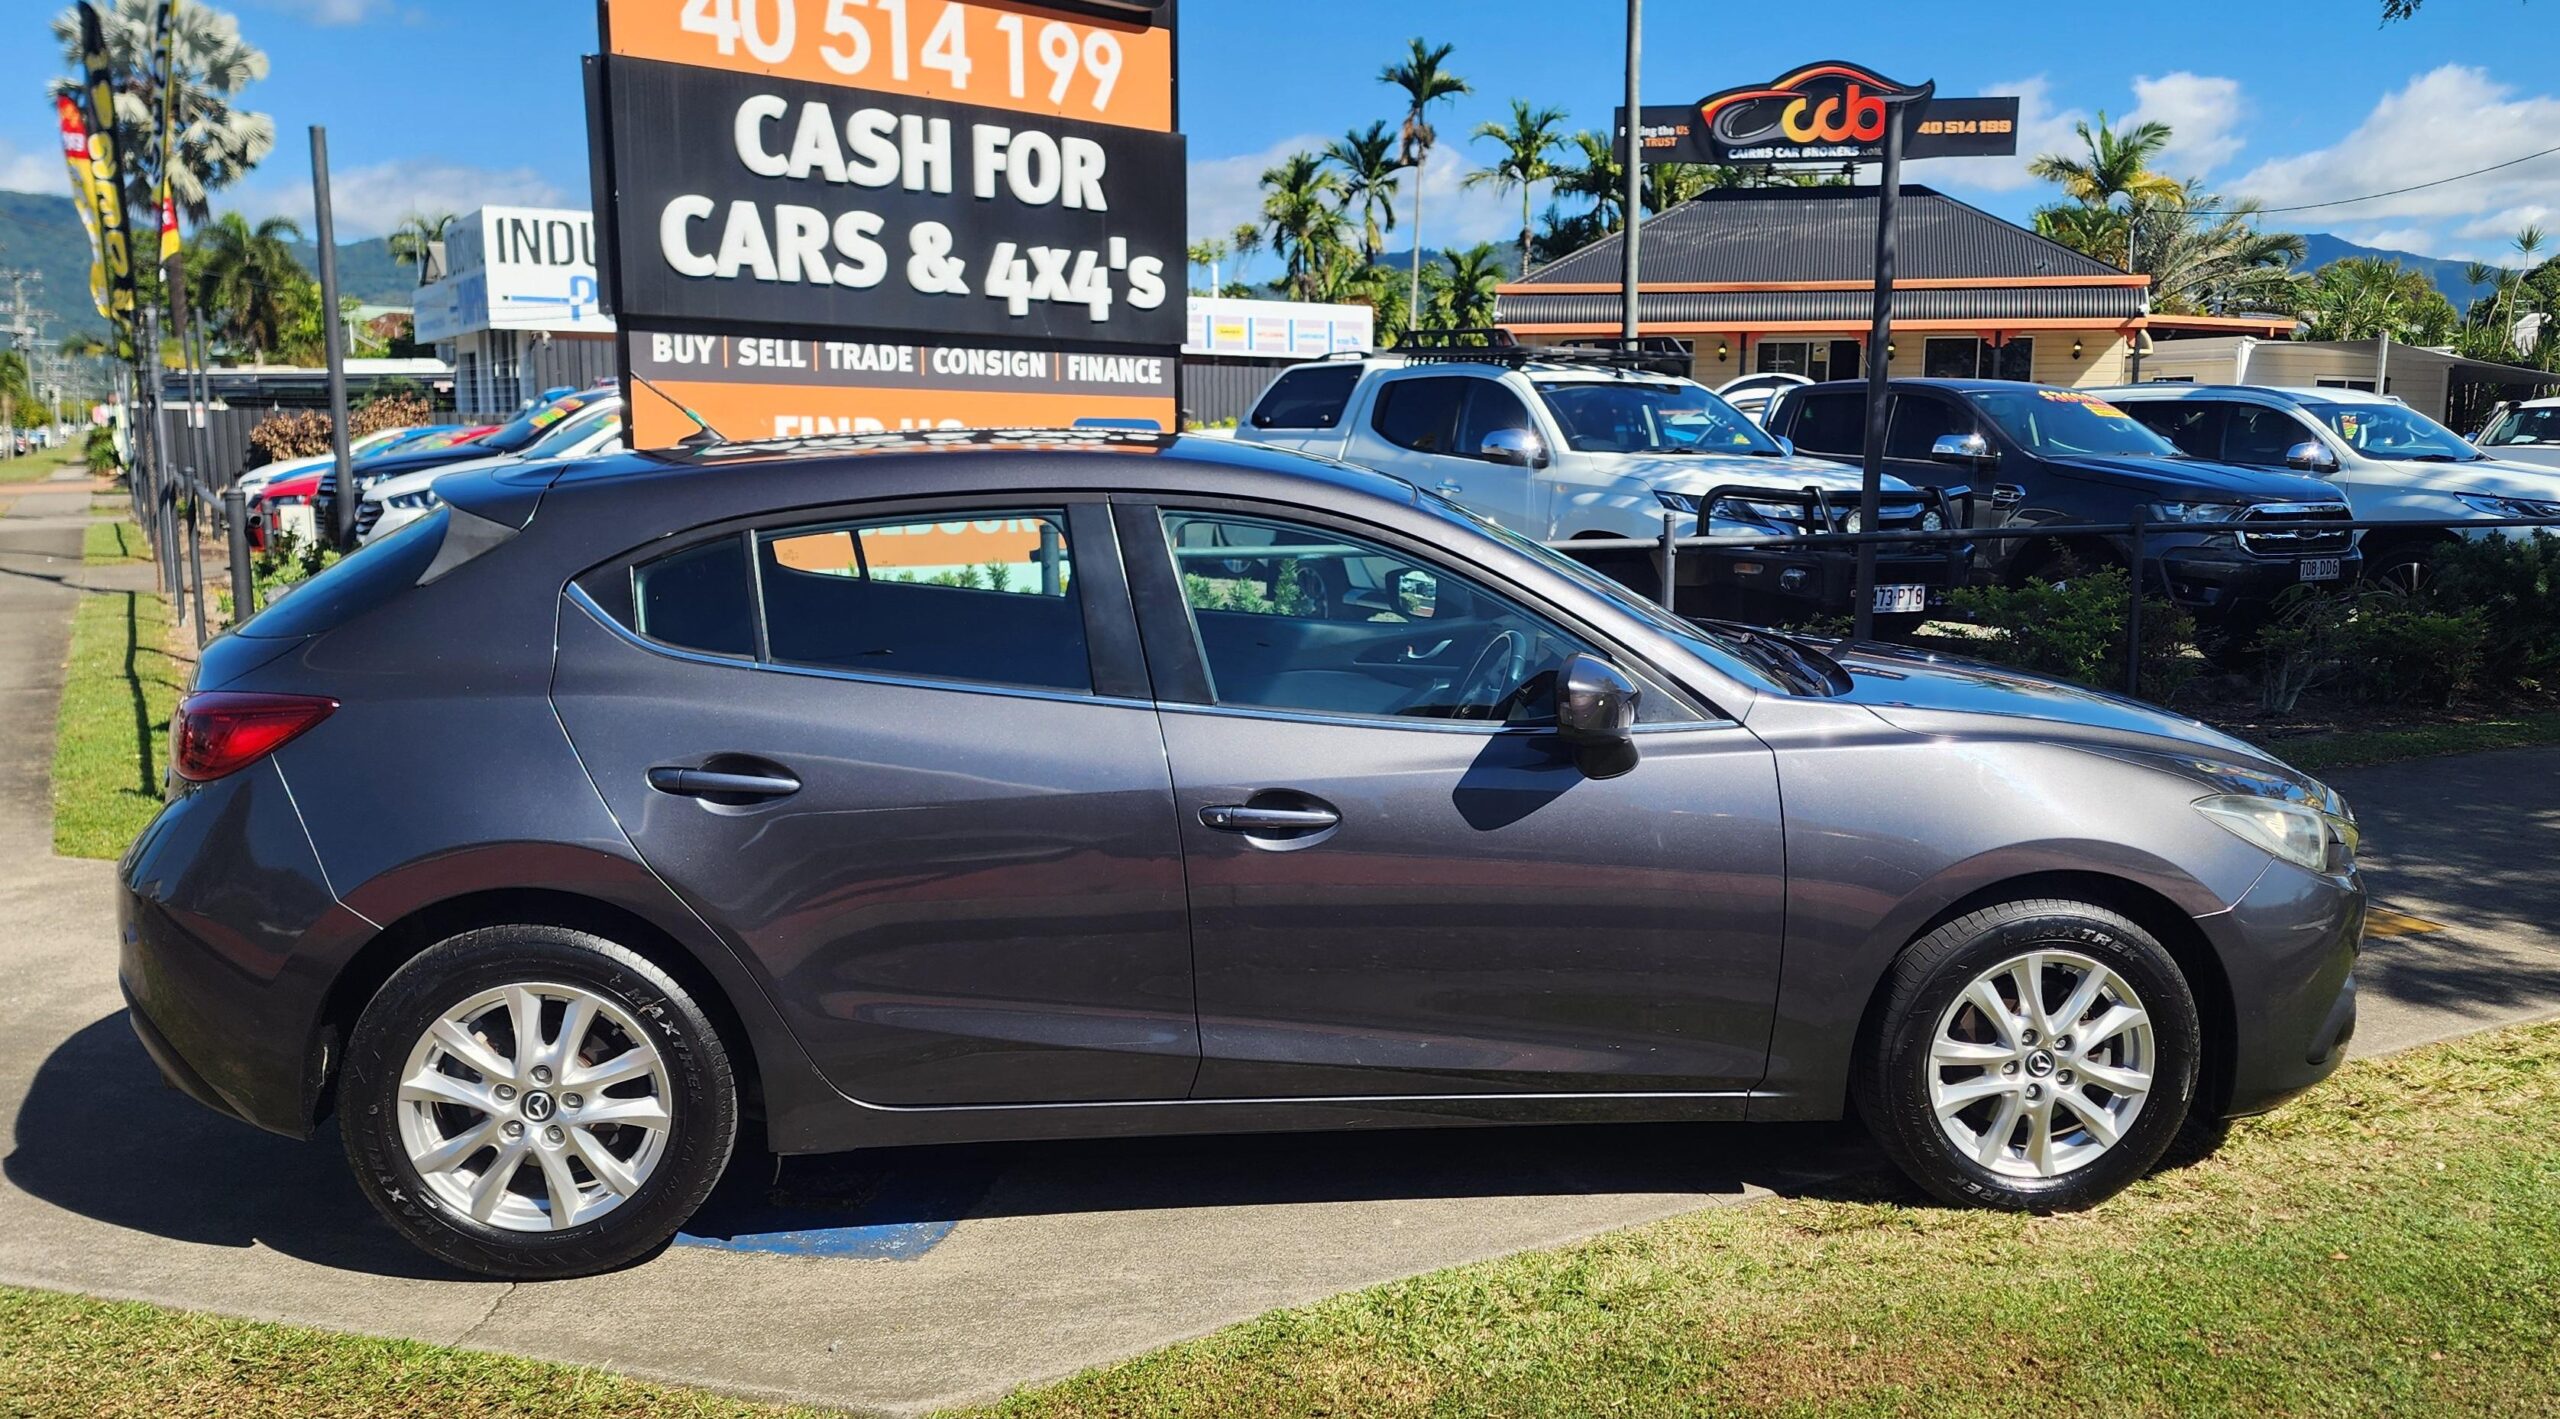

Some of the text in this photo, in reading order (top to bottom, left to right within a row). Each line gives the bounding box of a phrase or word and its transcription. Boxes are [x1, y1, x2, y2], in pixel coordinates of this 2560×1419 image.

[680, 0, 1123, 113] 40 514 199
[1644, 137, 1677, 147] TRUST
[1917, 119, 2012, 134] 40 514 199
[734, 94, 1108, 211] CASH FOR
[1728, 147, 1774, 159] CAIRNS
[1774, 147, 1800, 159] CAR
[660, 195, 888, 289] CARS
[906, 220, 970, 295] &
[652, 333, 1162, 384] BUY SELL TRADE CONSIGN FINANCE
[2020, 925, 2139, 962] AXTREK
